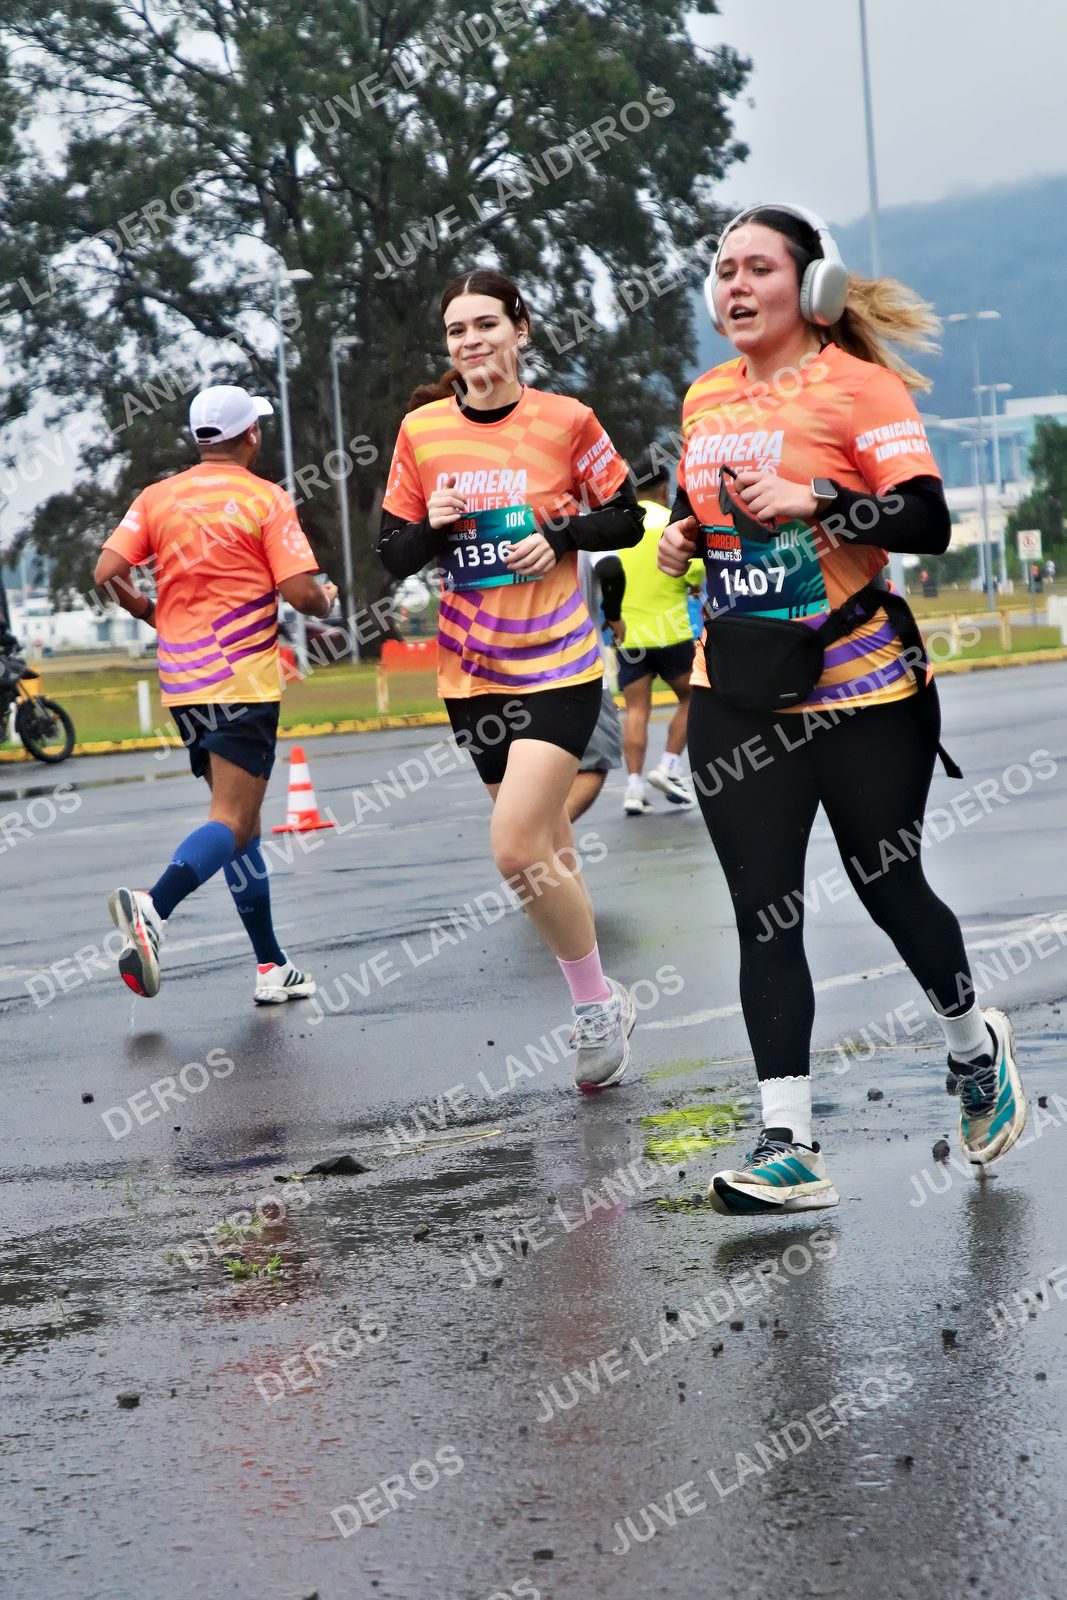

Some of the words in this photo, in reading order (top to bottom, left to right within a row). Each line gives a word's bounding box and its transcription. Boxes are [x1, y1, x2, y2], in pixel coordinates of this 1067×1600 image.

[685, 430, 784, 470] CARRERA
[505, 511, 526, 528] 10K
[707, 533, 741, 551] CARRERA
[776, 528, 800, 551] 10K
[454, 541, 513, 568] 1336
[708, 549, 734, 561] OMNILIFE
[720, 566, 786, 596] 1407
